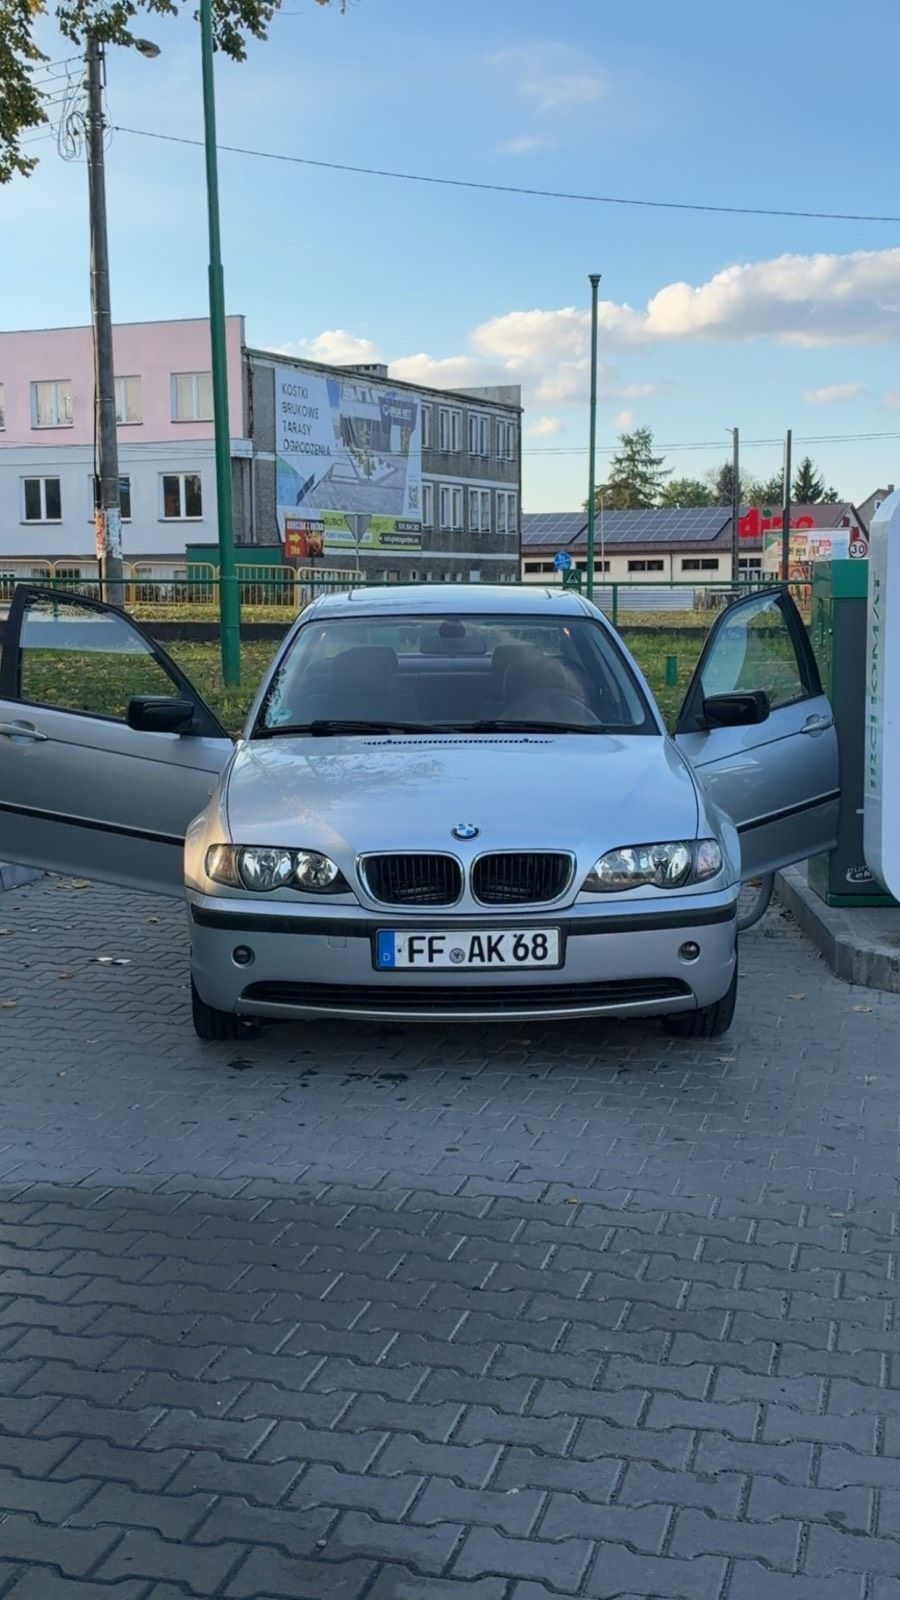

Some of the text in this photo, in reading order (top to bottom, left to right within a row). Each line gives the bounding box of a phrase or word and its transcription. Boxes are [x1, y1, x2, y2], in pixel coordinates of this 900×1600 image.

[281, 383, 309, 399] KOSTKI
[282, 402, 319, 420] BRUKOWE
[283, 420, 311, 436] TARASY
[283, 438, 331, 457] OGRODZENIA
[851, 544, 864, 554] 30
[408, 933, 548, 963] FF AK 68
